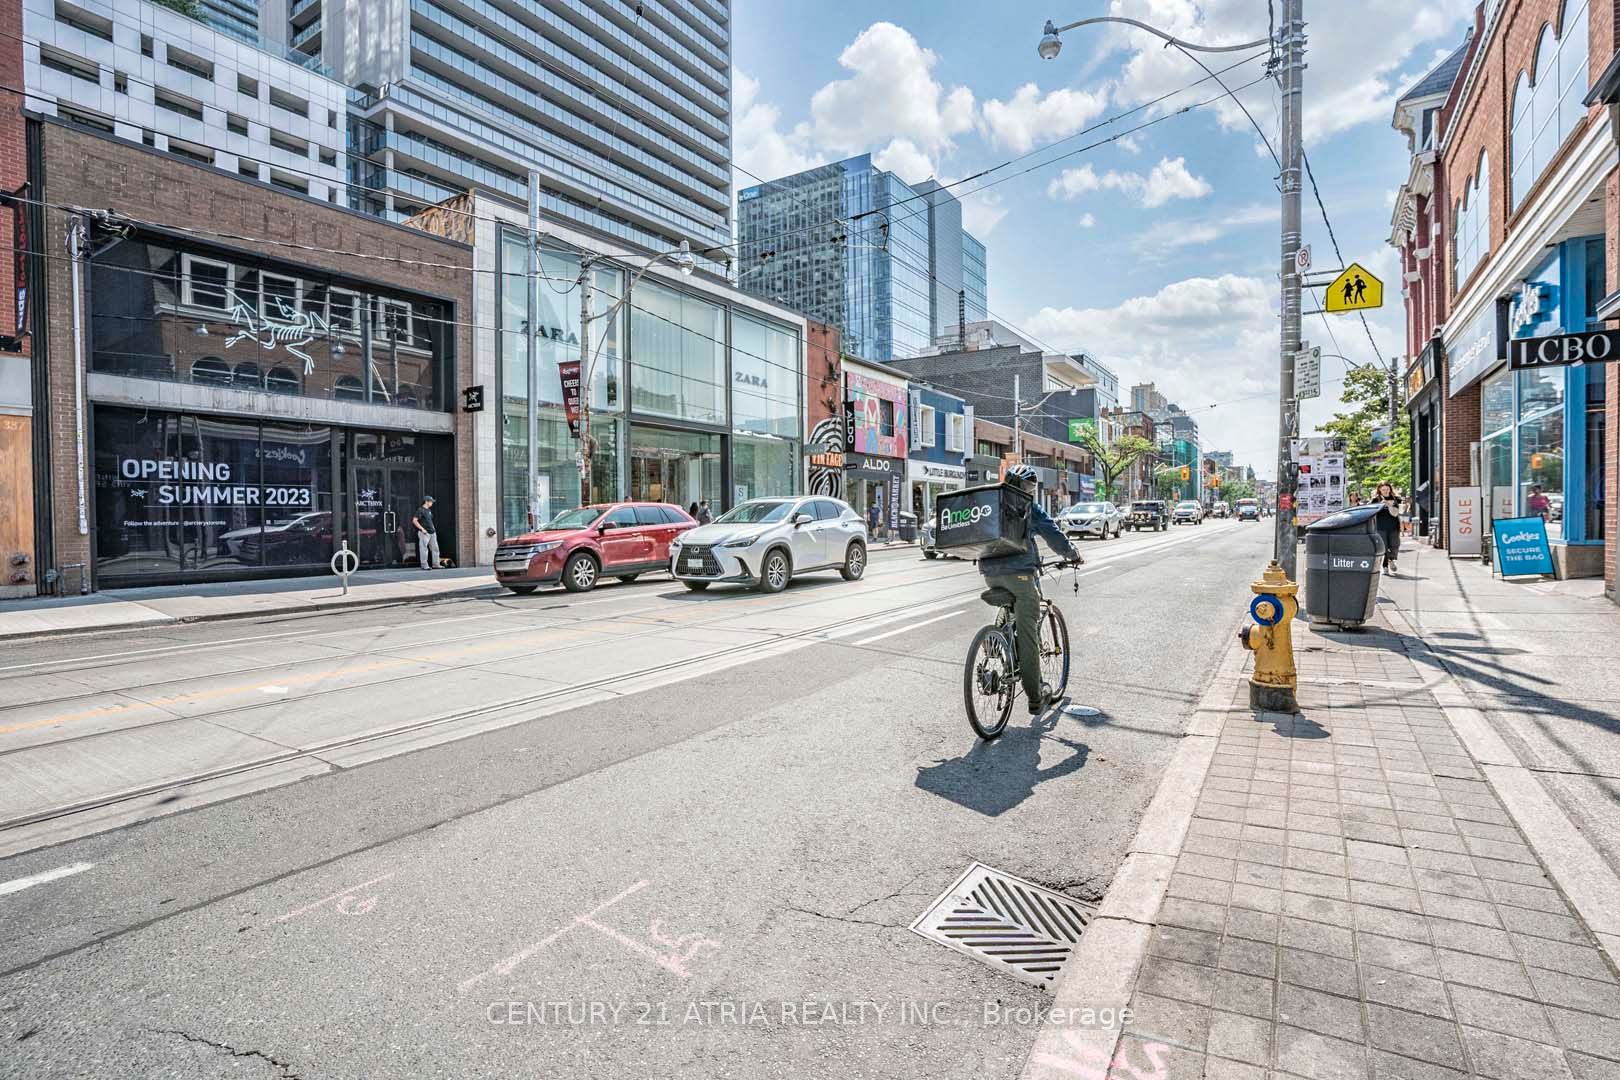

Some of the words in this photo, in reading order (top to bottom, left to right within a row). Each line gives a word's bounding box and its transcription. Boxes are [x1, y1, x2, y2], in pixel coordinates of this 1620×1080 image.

[1520, 334, 1612, 365] LCBO
[735, 371, 768, 388] ZARA
[846, 410, 854, 444] ALDO
[122, 459, 231, 480] OPENING
[862, 458, 890, 471] ALDO
[159, 485, 260, 505] SUMMER
[265, 488, 310, 505] 2023
[941, 505, 992, 525] Amego
[1459, 496, 1473, 535] SALE
[1501, 530, 1540, 544] Cookies
[1506, 546, 1541, 555] SECURE
[1333, 558, 1354, 568] Litter
